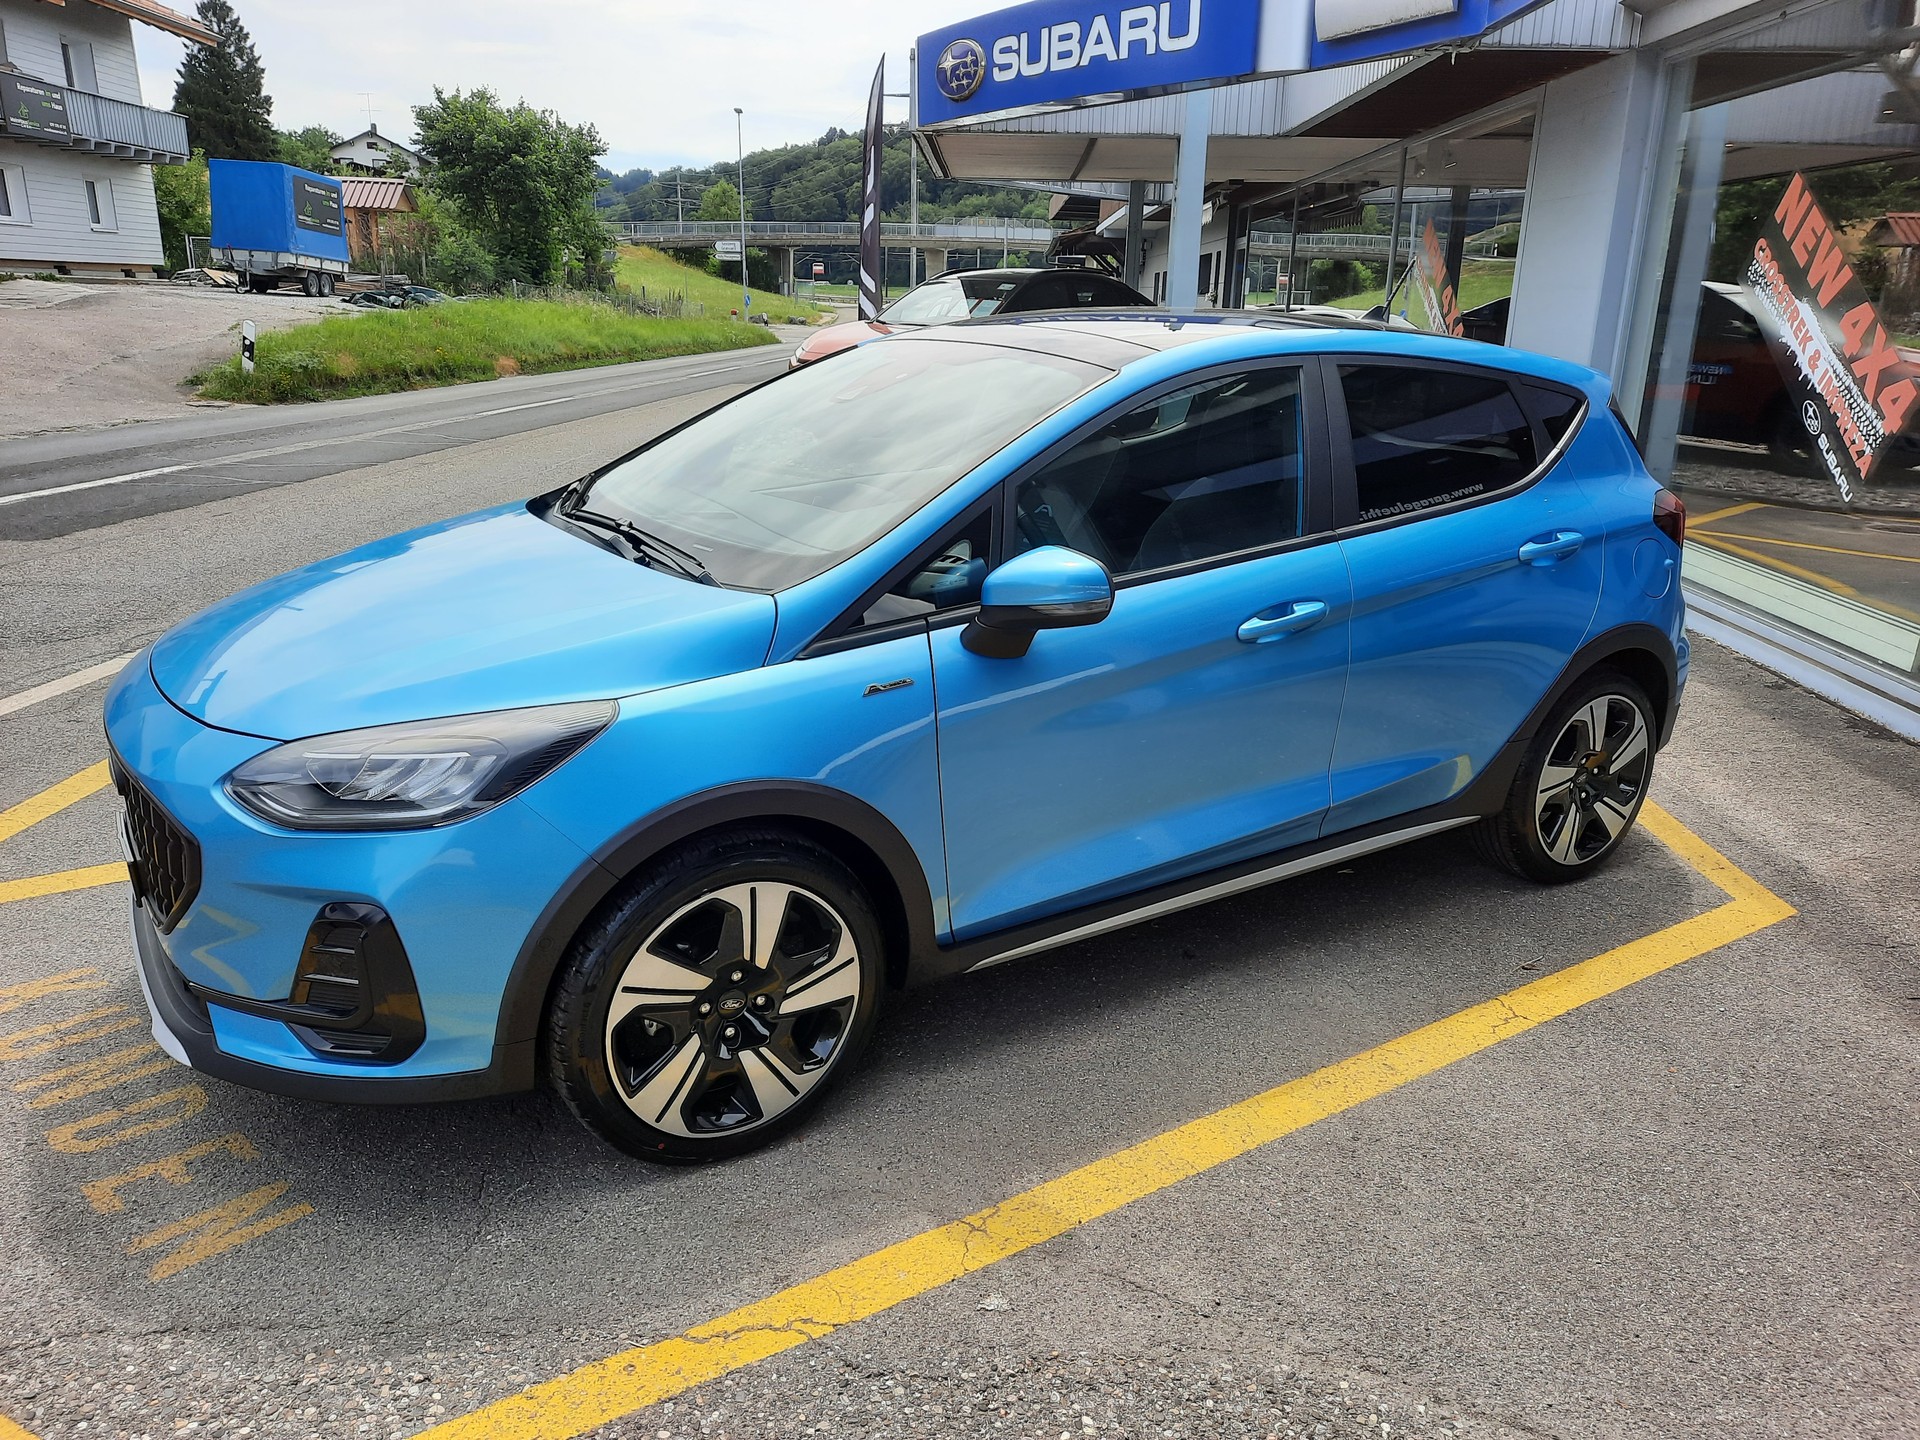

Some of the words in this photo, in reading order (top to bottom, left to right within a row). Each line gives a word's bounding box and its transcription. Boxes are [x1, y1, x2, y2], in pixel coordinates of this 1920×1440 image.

[992, 0, 1201, 82] SUBARU
[1754, 237, 1813, 356] CROSSTREK
[1808, 349, 1822, 372] &
[1816, 368, 1874, 480] IMPREZA
[1774, 172, 1853, 309] NEW
[1839, 302, 1917, 436] 4X4
[1817, 433, 1854, 503] SUBARU
